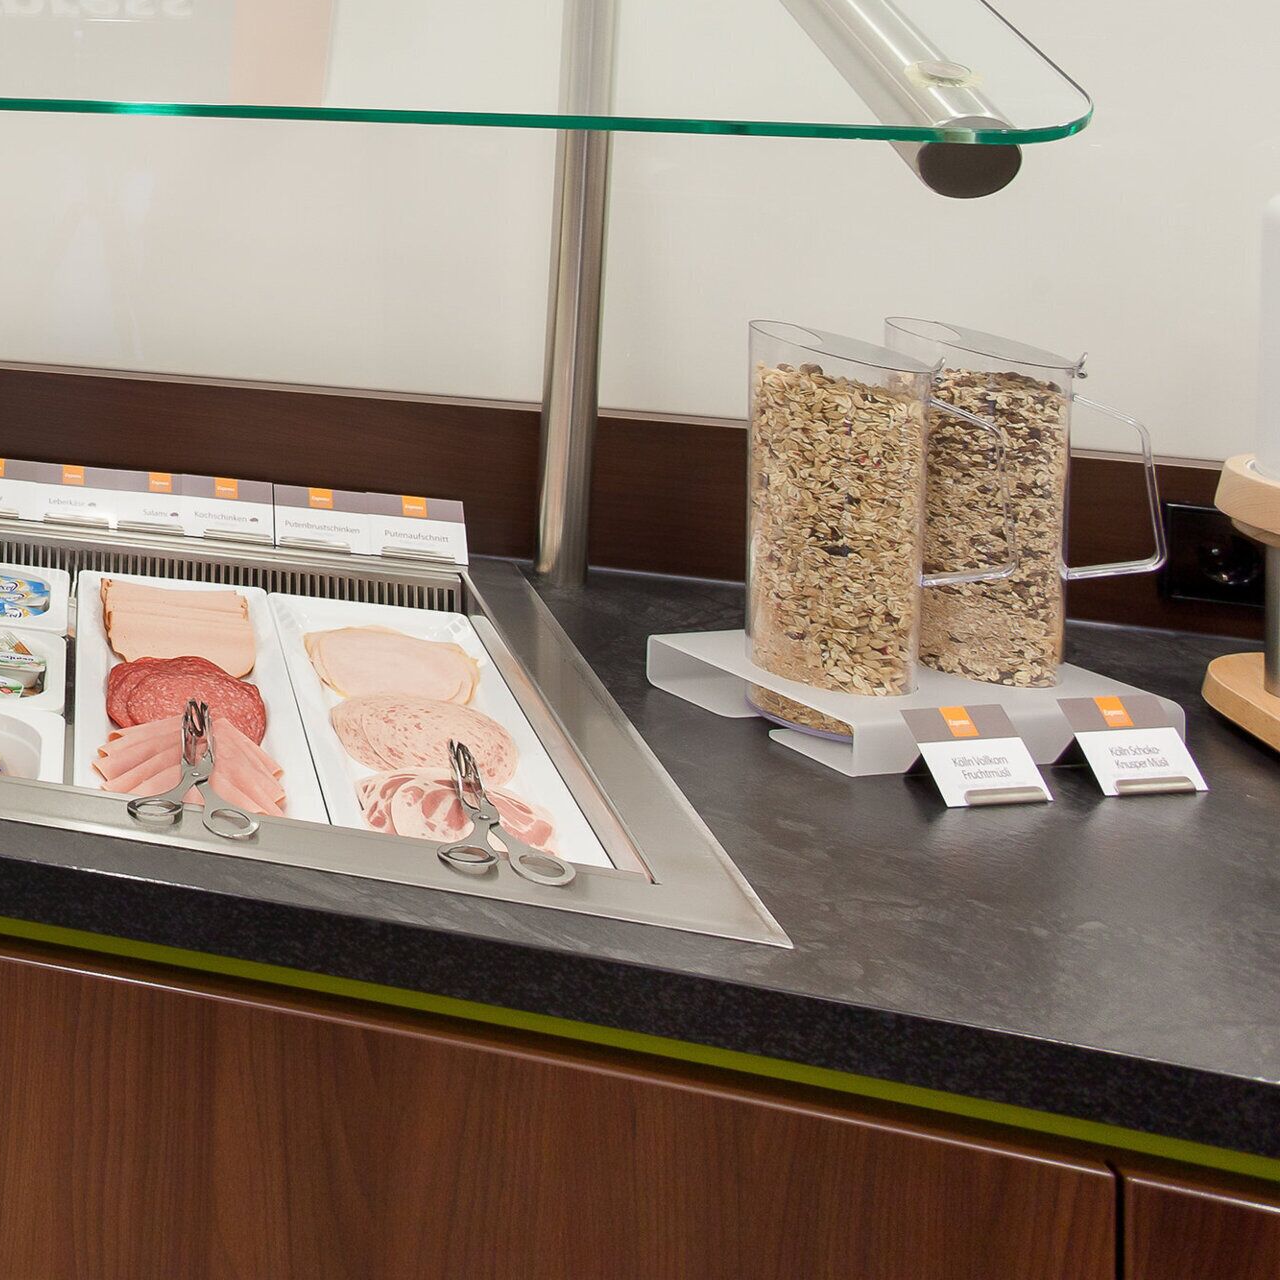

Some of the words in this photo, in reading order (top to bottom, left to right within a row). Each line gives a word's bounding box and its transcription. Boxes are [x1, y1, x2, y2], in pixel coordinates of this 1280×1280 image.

[194, 511, 247, 523] Kochschinken
[284, 520, 361, 535] Putenbrustschinken
[384, 529, 449, 543] Putenaufschnitt
[1114, 759, 1148, 770] Knusper
